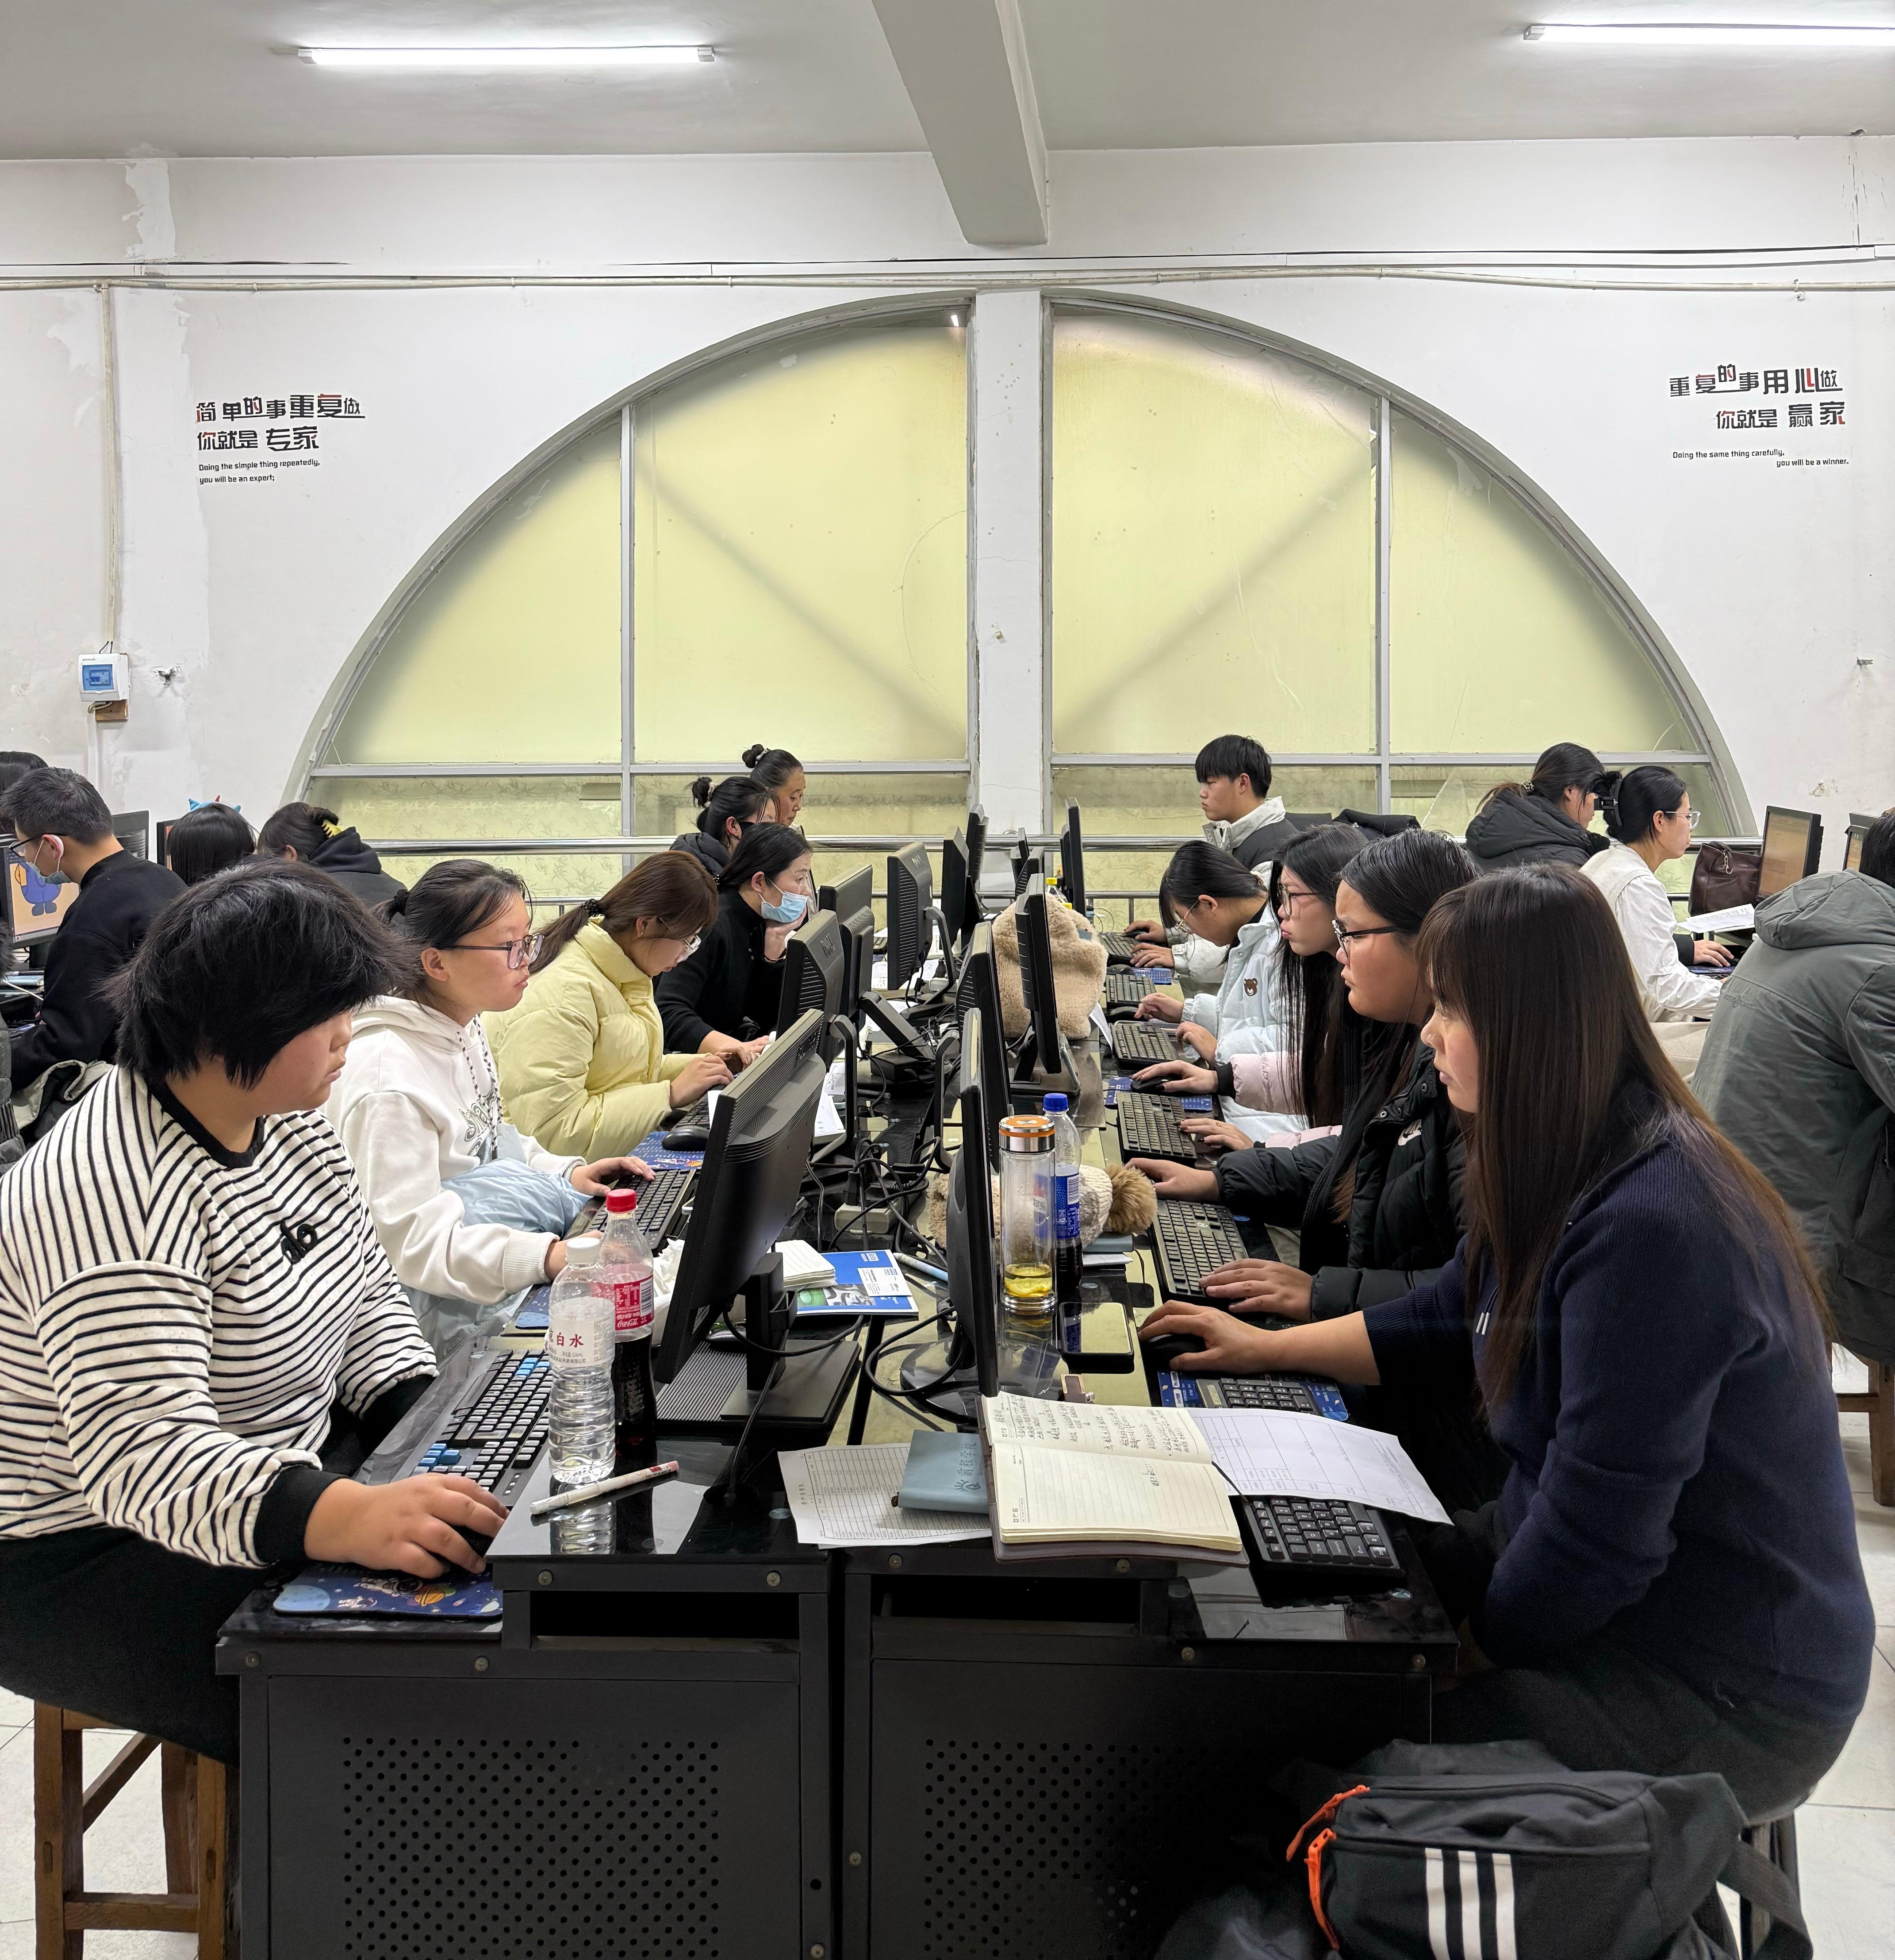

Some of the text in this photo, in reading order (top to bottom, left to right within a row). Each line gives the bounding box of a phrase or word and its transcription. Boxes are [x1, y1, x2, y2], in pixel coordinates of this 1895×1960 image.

[1669, 364, 1843, 397] 重复的事用心做
[196, 393, 365, 423] 简单的事重复做
[1716, 401, 1845, 429] 你就是赢家
[197, 426, 319, 452] 你就是专家
[280, 459, 320, 468] repeatedly,
[1731, 450, 1749, 458] thing
[249, 474, 275, 483] expert;
